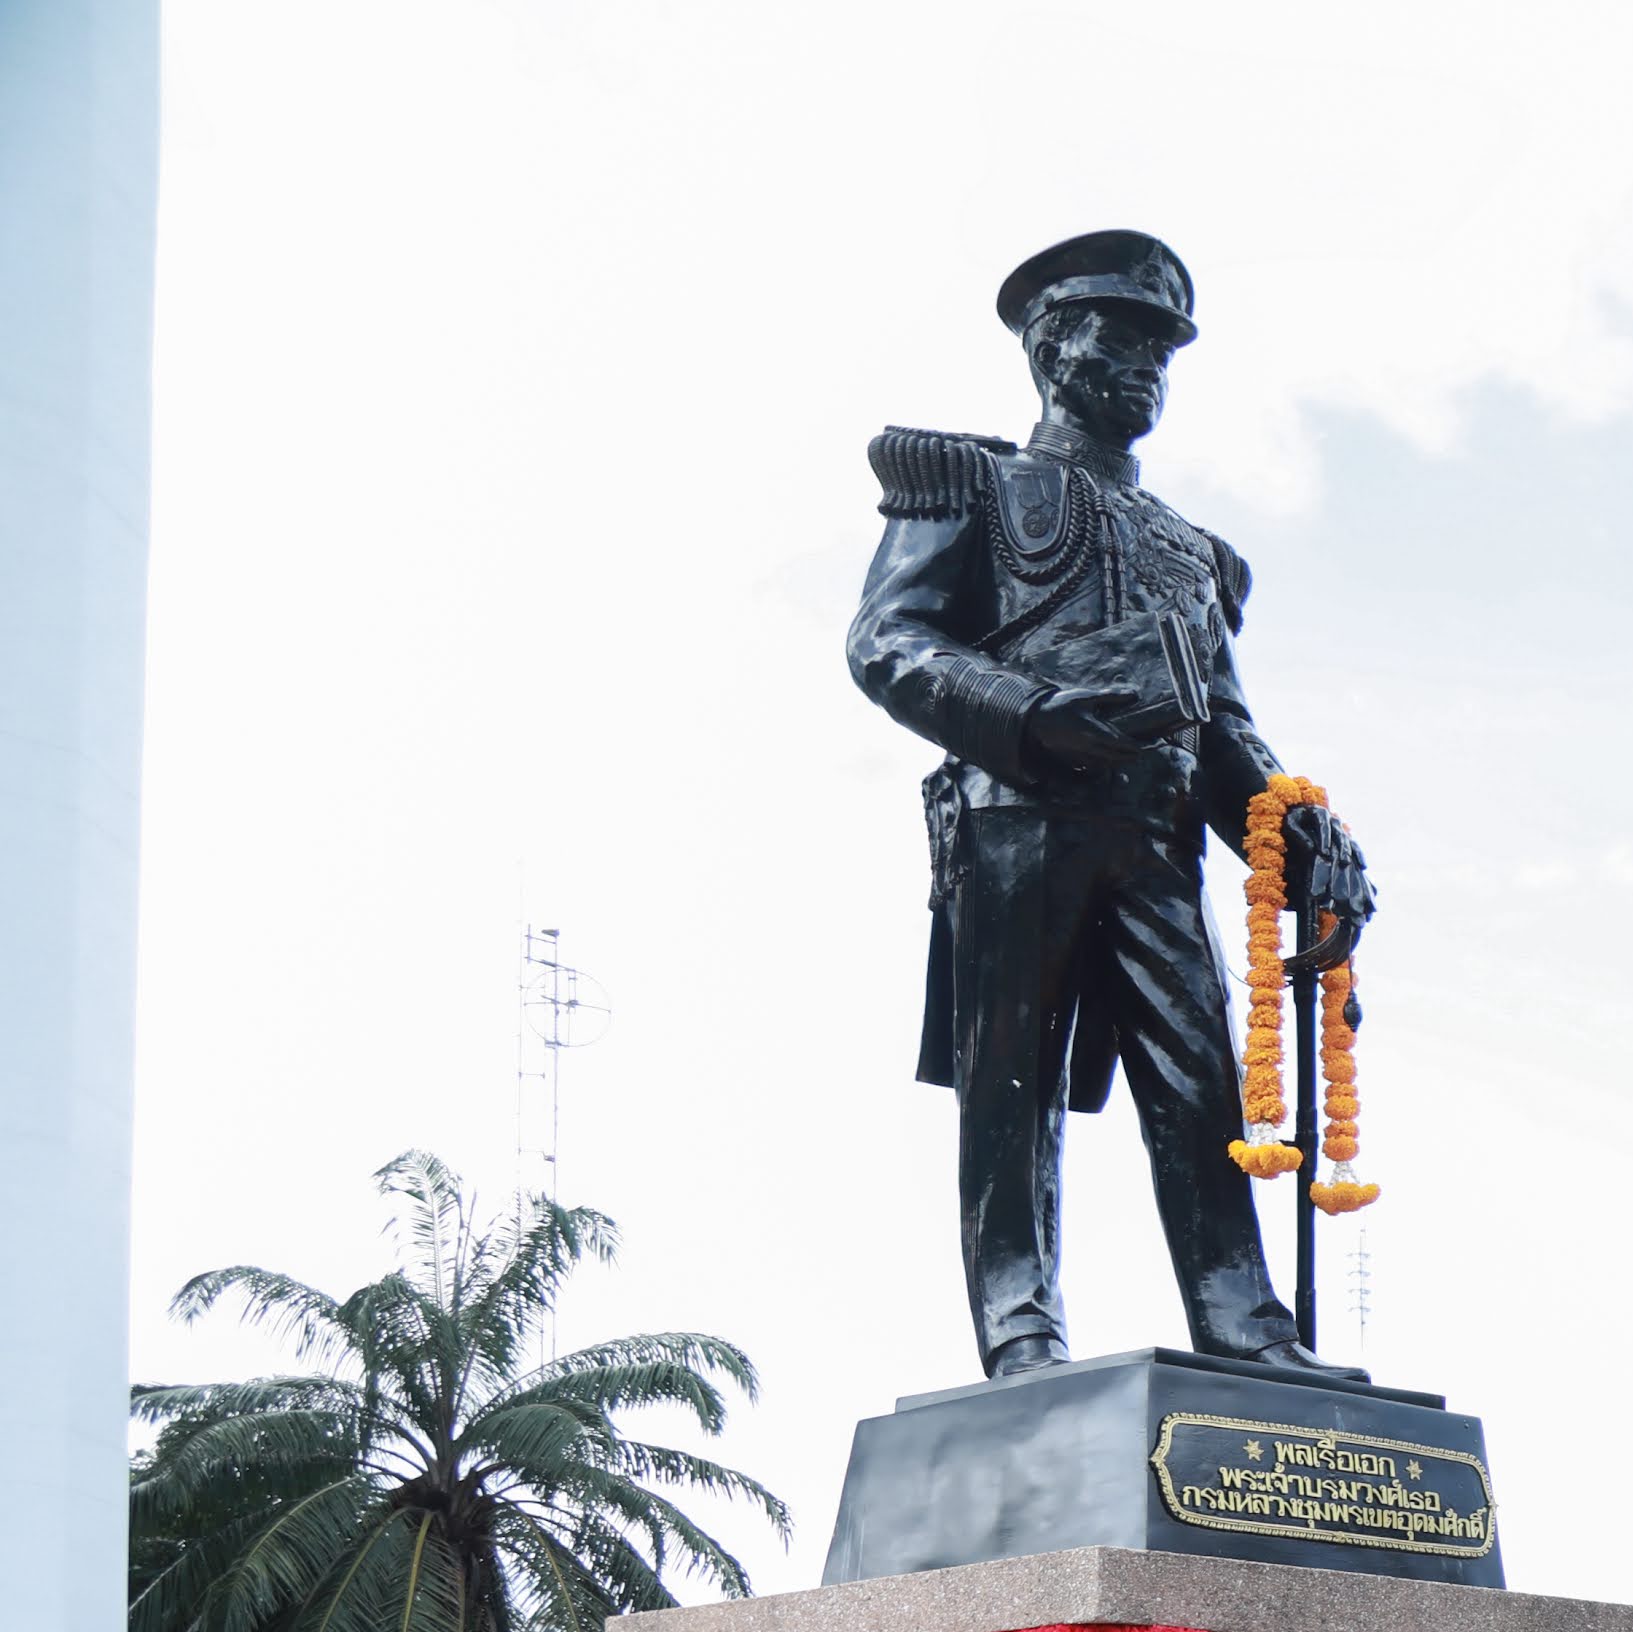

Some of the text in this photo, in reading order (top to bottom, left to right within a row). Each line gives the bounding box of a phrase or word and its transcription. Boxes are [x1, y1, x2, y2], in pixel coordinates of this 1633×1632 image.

[1274, 1437, 1396, 1477] พลเรือเอก
[1219, 1463, 1441, 1511] พระเจ้าบรมวงศ์เธอ
[1182, 1484, 1487, 1541] กรมหลวงชุมพรเขตอุดมศักดิ์
